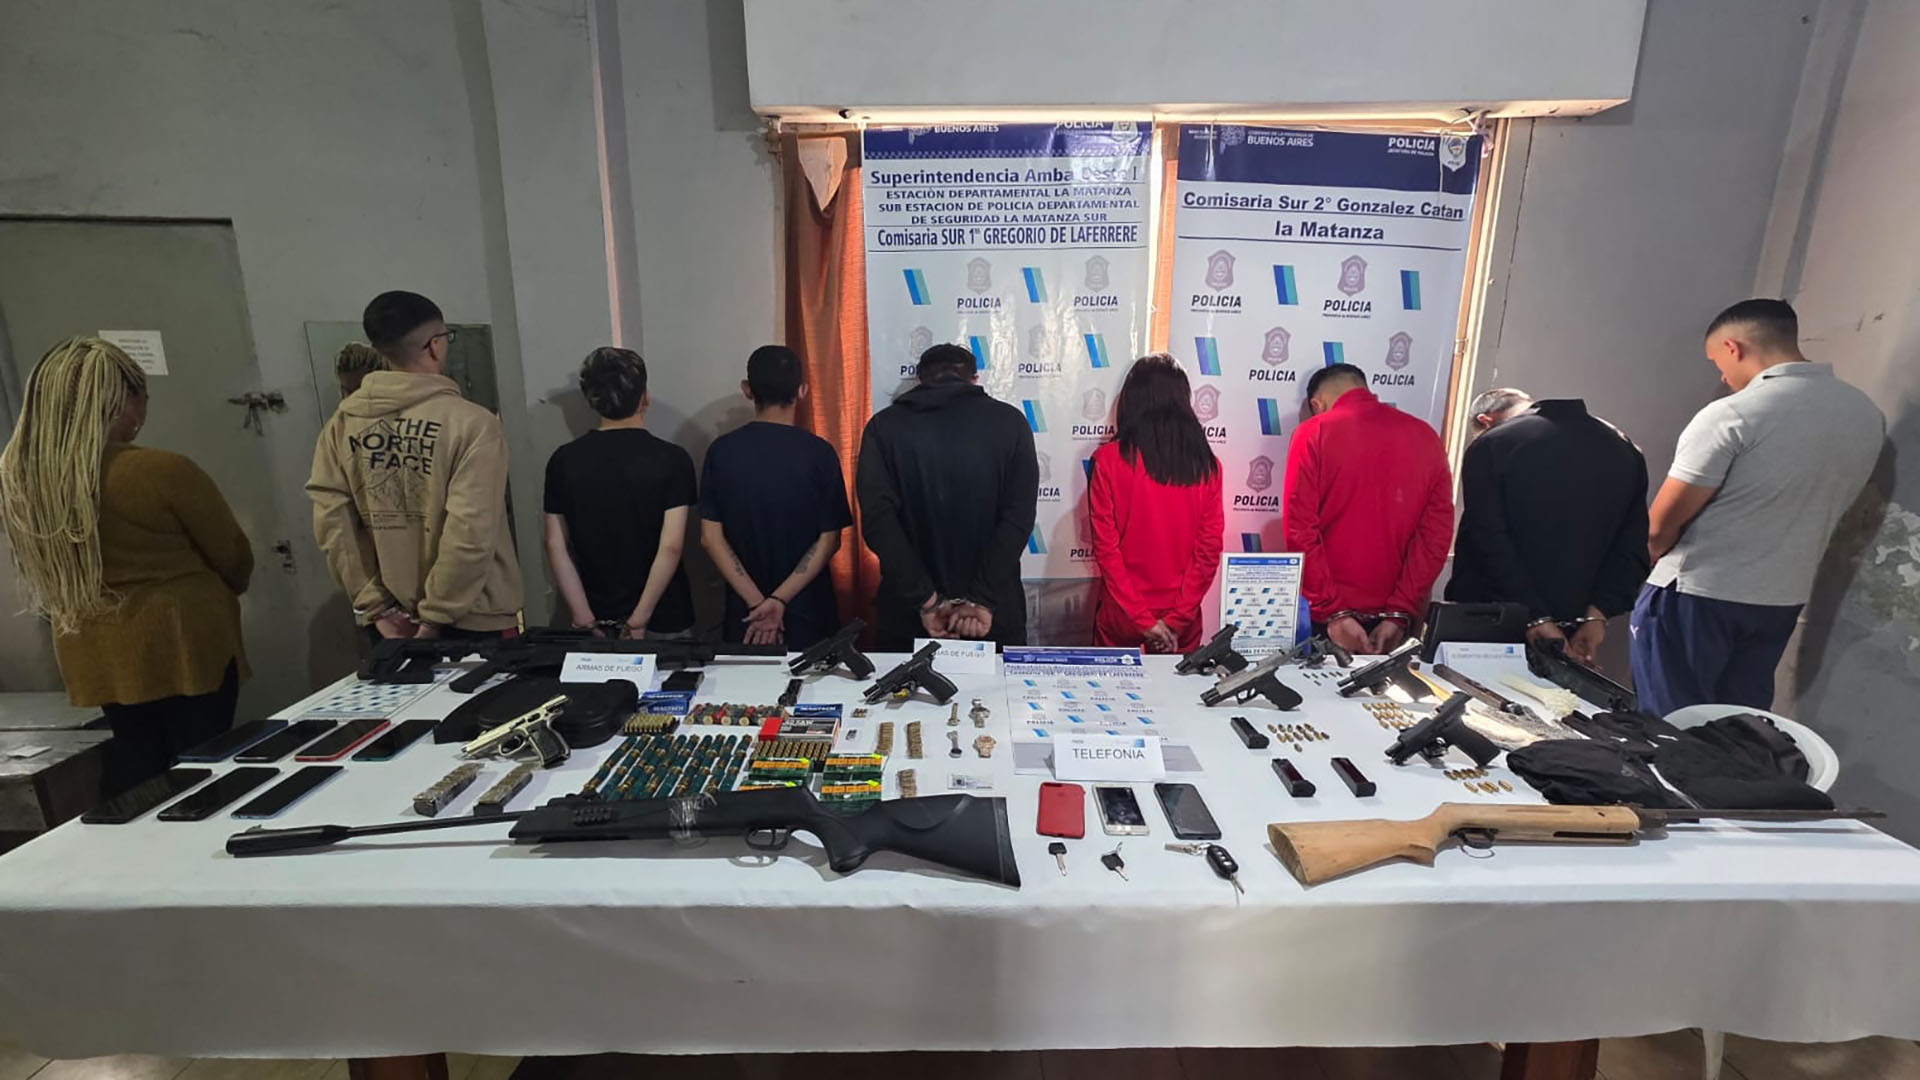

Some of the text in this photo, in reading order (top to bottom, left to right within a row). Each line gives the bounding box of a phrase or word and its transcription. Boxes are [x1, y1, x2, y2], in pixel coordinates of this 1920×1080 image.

[973, 124, 999, 133] AIRES
[1247, 135, 1314, 147] BUENOS AIRES
[870, 168, 1019, 187] Superintendencia
[1025, 167, 1074, 182] Amba
[949, 187, 1051, 199] DEPARTAMENTAL
[1054, 187, 1070, 197] LA
[1073, 186, 1132, 197] MATANZA
[878, 199, 1140, 213] SUB ESTACION DE POLICIA DEPARTAMENTAL
[1183, 191, 1272, 209] Comisaria
[1279, 195, 1308, 211] Sur
[1337, 198, 1415, 216] Gonzalez
[1420, 202, 1464, 219] Catan
[911, 212, 1108, 225] DE SEGURIDAD LA MATANZA SUR
[877, 228, 938, 246] Comisaria
[941, 227, 966, 245] SUR
[983, 226, 1047, 244] GREGORIO
[1050, 225, 1067, 243] DE
[1070, 224, 1138, 243] LAFERRERE
[1274, 220, 1384, 240] la Matanza
[957, 297, 1001, 309] POLICIA
[1074, 295, 1119, 307] POLICIA
[1191, 294, 1242, 307] POLICIA
[1323, 299, 1372, 312] POLICIA
[1018, 363, 1062, 374] POLICIA
[1249, 369, 1297, 382] POLICIA
[1372, 373, 1415, 386] POLICIA
[394, 417, 442, 439] THE
[1072, 425, 1116, 435] POLICIA
[348, 431, 436, 458] NORTH
[369, 451, 433, 476] FACE
[1038, 487, 1061, 497] ICIA
[1233, 495, 1280, 507] POLICIA
[604, 664, 615, 672] DE
[1072, 747, 1145, 760] TELEFONIA
